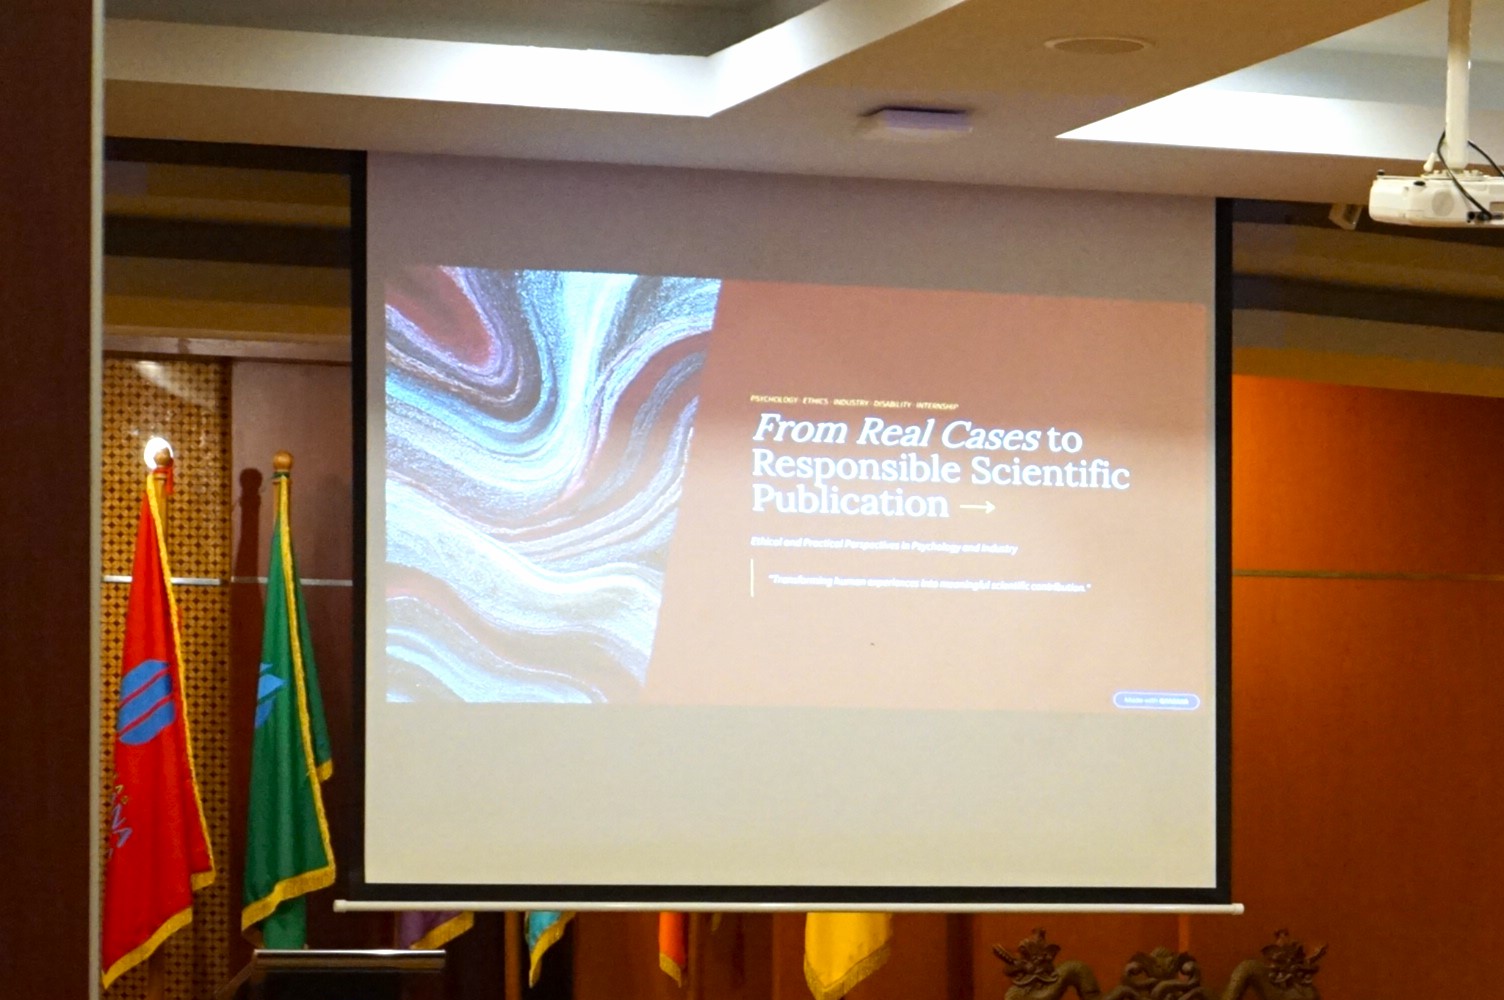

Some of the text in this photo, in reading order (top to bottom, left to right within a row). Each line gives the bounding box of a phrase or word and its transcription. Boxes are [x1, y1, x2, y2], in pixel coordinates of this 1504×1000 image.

[751, 395, 960, 411] PSYCHOLOGY ETHICS INDUSTRY DISABILITY INTERNSHIP
[752, 413, 1083, 453] From Real Cases to
[752, 448, 1130, 490] Responsible Scientific
[752, 483, 950, 518] Publication
[750, 536, 1018, 555] Ethical and Practical Perspectives in Psychology and Industry
[834, 576, 866, 586] human
[866, 577, 920, 588] experiences
[920, 579, 939, 588] into
[939, 580, 991, 591] meaningful
[991, 581, 1030, 591] scientific
